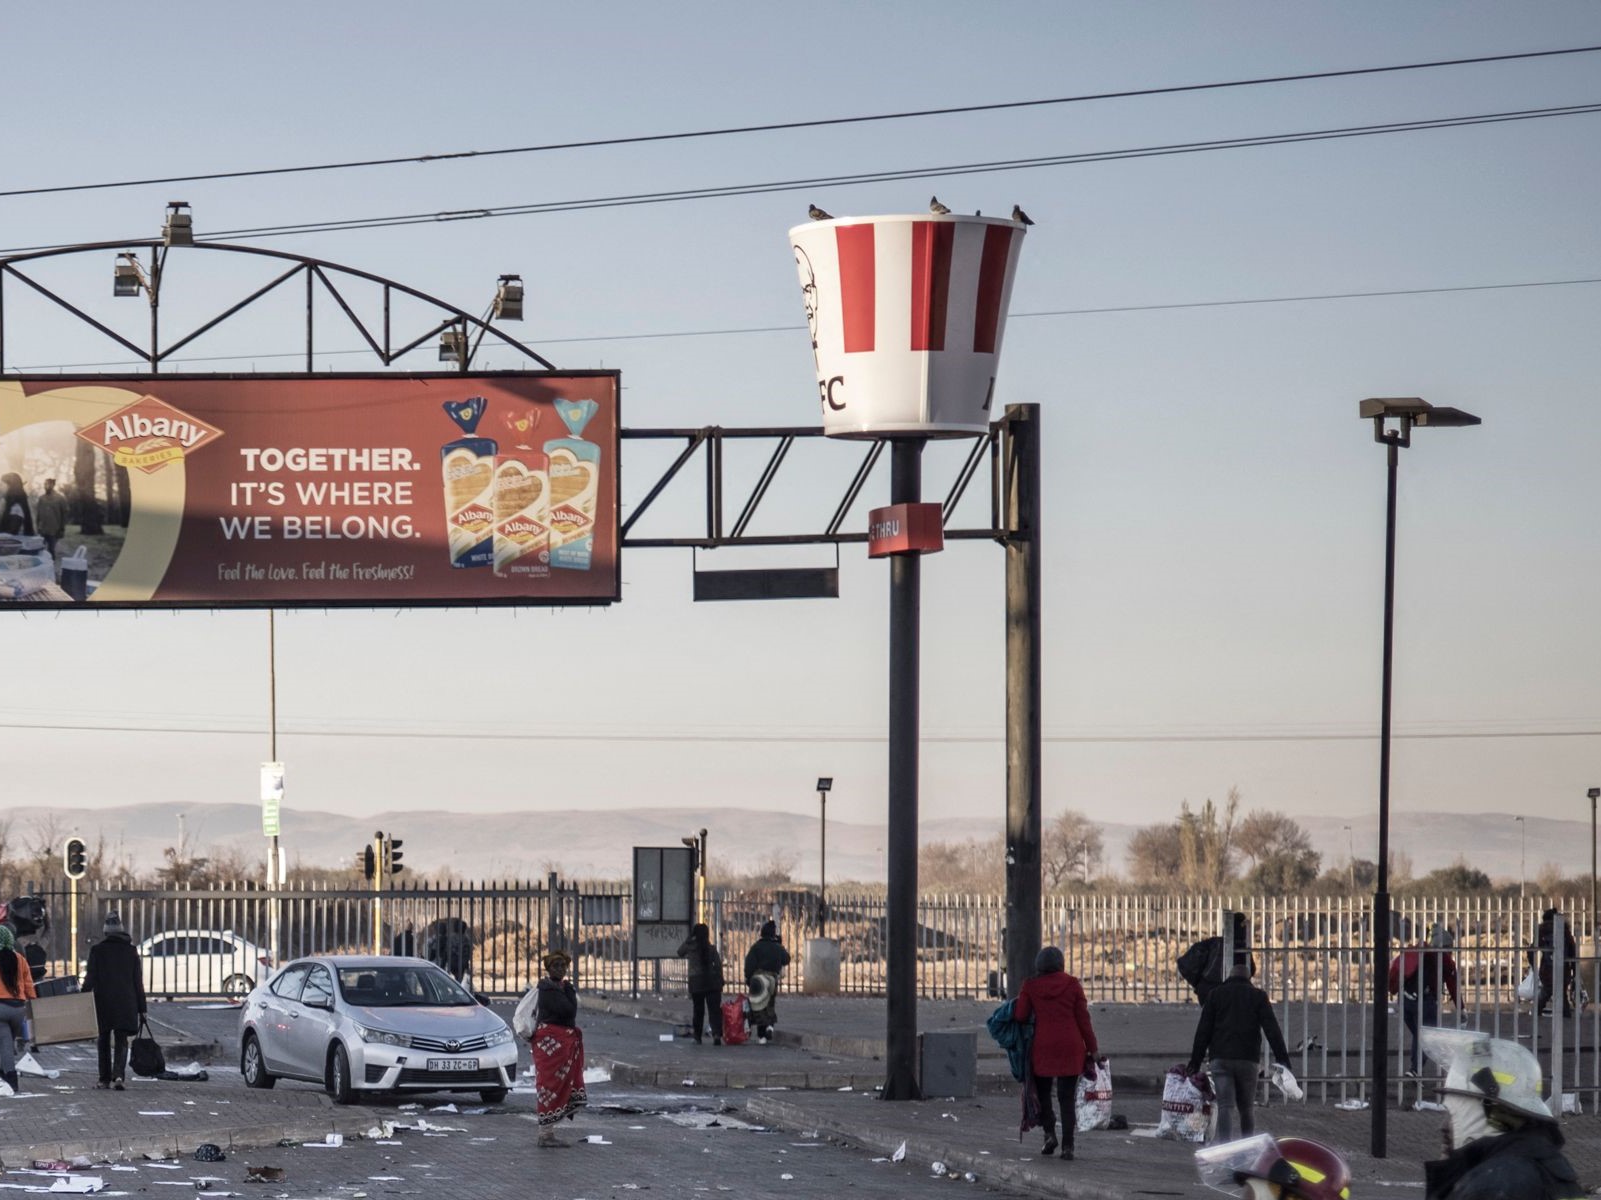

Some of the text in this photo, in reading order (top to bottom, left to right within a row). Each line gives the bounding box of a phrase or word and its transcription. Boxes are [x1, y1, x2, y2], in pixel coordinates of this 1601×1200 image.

[819, 376, 846, 414] FC
[104, 413, 207, 447] Albany
[121, 449, 173, 464] BAKERIES
[240, 448, 421, 471] TOGETHER.
[231, 482, 413, 506] IT’S WHERE
[219, 515, 421, 540] WE BELONG.
[505, 522, 543, 536] Albany
[876, 520, 899, 539] THRU
[218, 562, 241, 581] Feel
[245, 562, 265, 581] the
[302, 561, 326, 581] Feel
[329, 562, 350, 580] the
[353, 562, 415, 581] Freshness!
[1163, 1103, 1191, 1111] ENTITY
